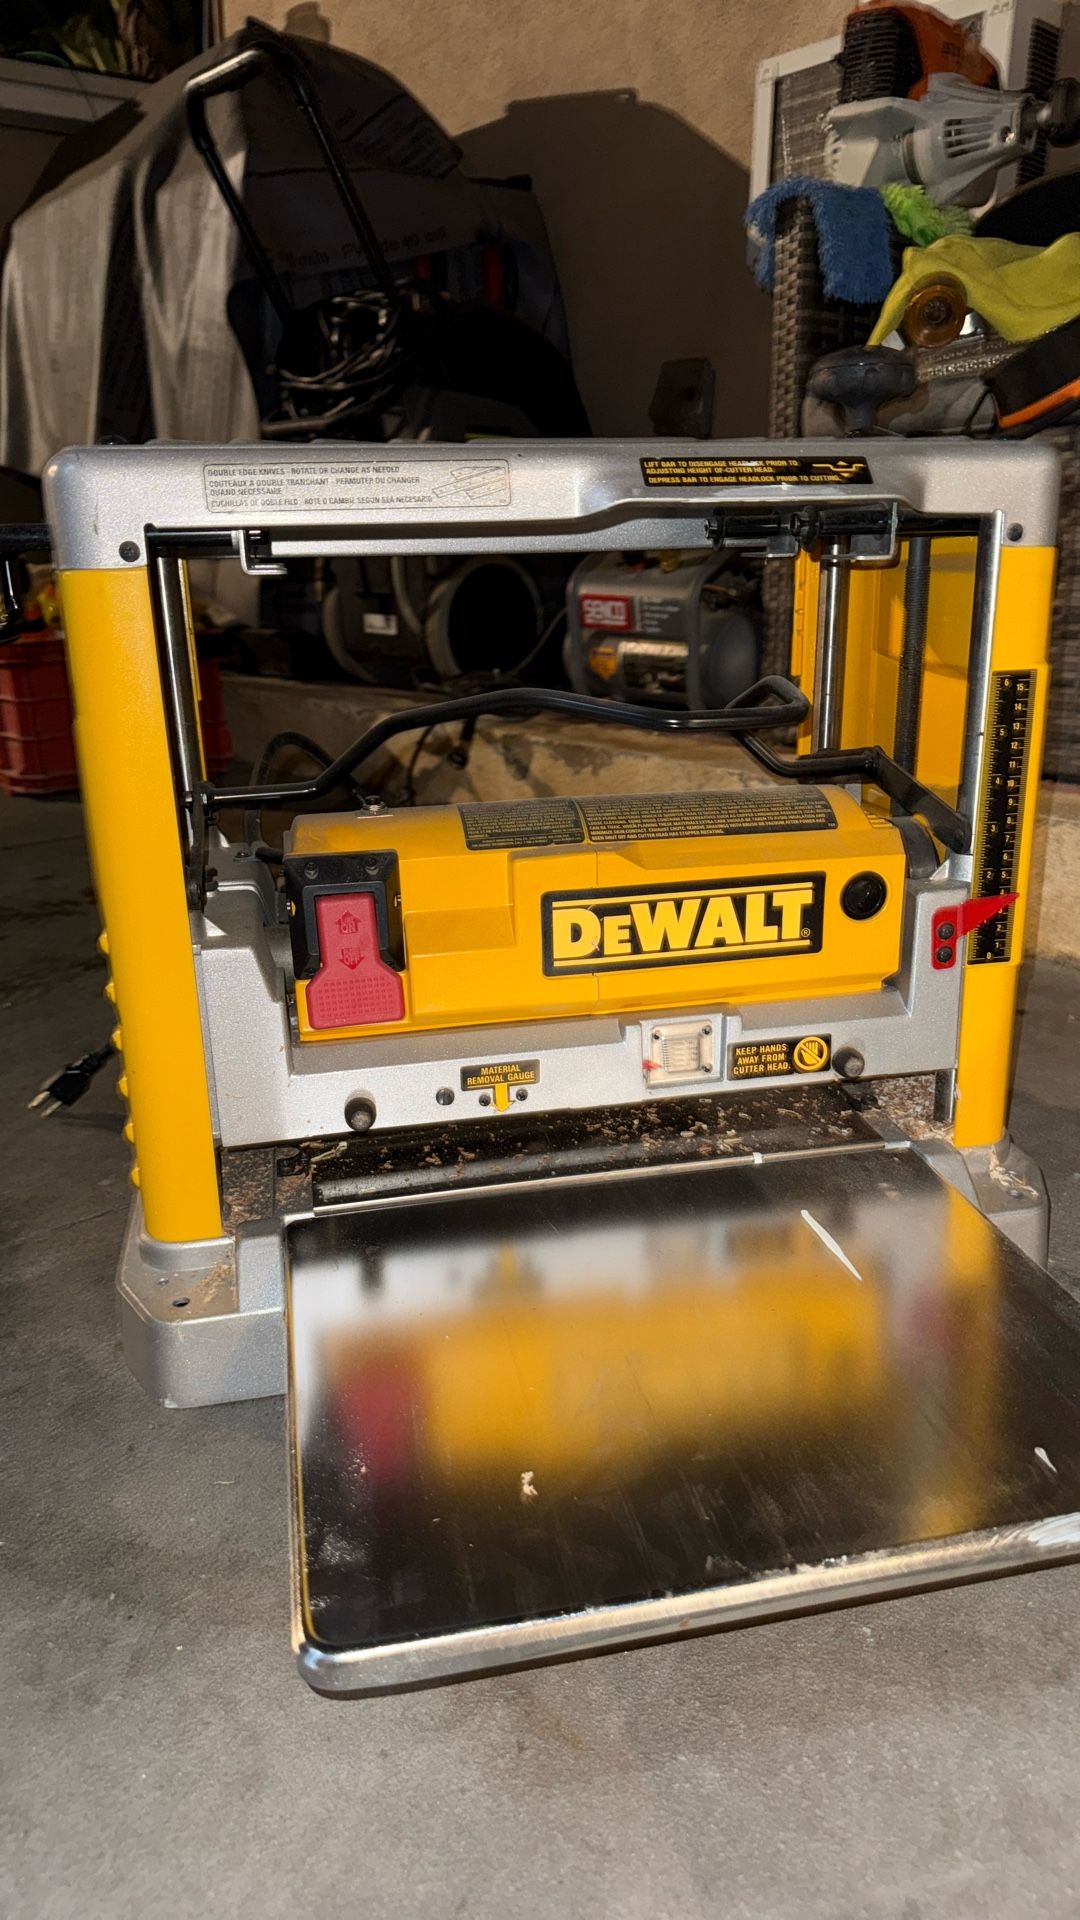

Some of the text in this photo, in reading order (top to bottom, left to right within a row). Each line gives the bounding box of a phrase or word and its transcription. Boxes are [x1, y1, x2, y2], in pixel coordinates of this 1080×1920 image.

[238, 468, 257, 476] EDGE
[259, 467, 285, 475] KNIVES
[291, 467, 317, 475] ROTATE
[318, 467, 328, 475] OR
[330, 466, 360, 474] CHANGE
[209, 479, 247, 487] COUTEAUX
[256, 479, 284, 487] DOUBLE
[286, 478, 329, 486] TRANCHANT
[387, 476, 420, 484] CHANGER
[210, 489, 236, 497] QUAND
[999, 728, 1005, 736] 5
[995, 777, 1000, 785] 4
[1005, 835, 1010, 843] 7
[735, 1044, 788, 1056] KEEP HANDS
[737, 1053, 785, 1065] AWAY FROM
[480, 1064, 520, 1076] MATERIAL
[733, 1062, 791, 1075] CUTTER HEAD.
[467, 1071, 535, 1086] REMOVAL GAUGE
